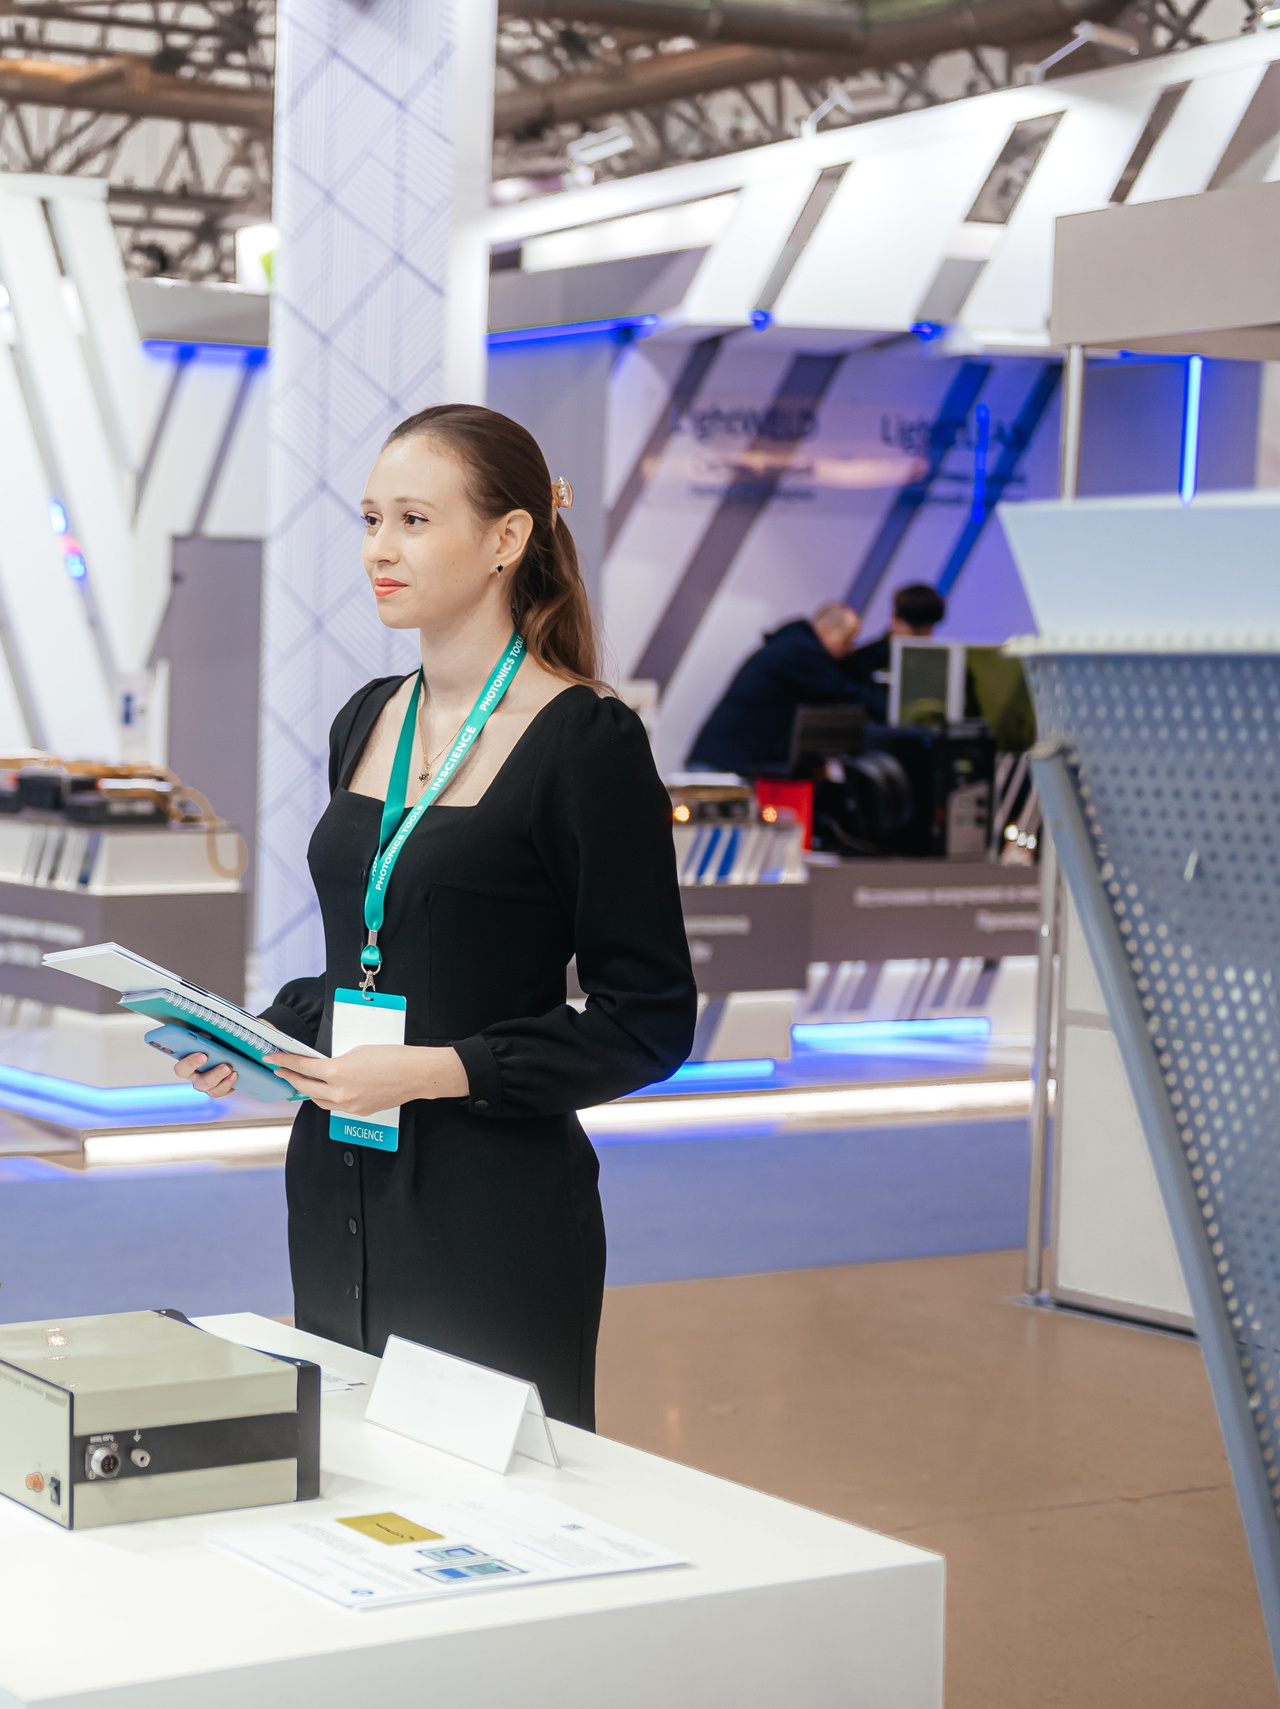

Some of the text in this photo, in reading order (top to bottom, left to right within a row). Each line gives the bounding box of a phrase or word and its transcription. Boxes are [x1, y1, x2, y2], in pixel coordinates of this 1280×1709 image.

[375, 834, 405, 891] PHOTONICS
[401, 805, 424, 834] TOOLS
[430, 725, 477, 791] INSCIENCE
[479, 656, 516, 712] PHOTONICS
[344, 1124, 384, 1142] INSCIENCE
